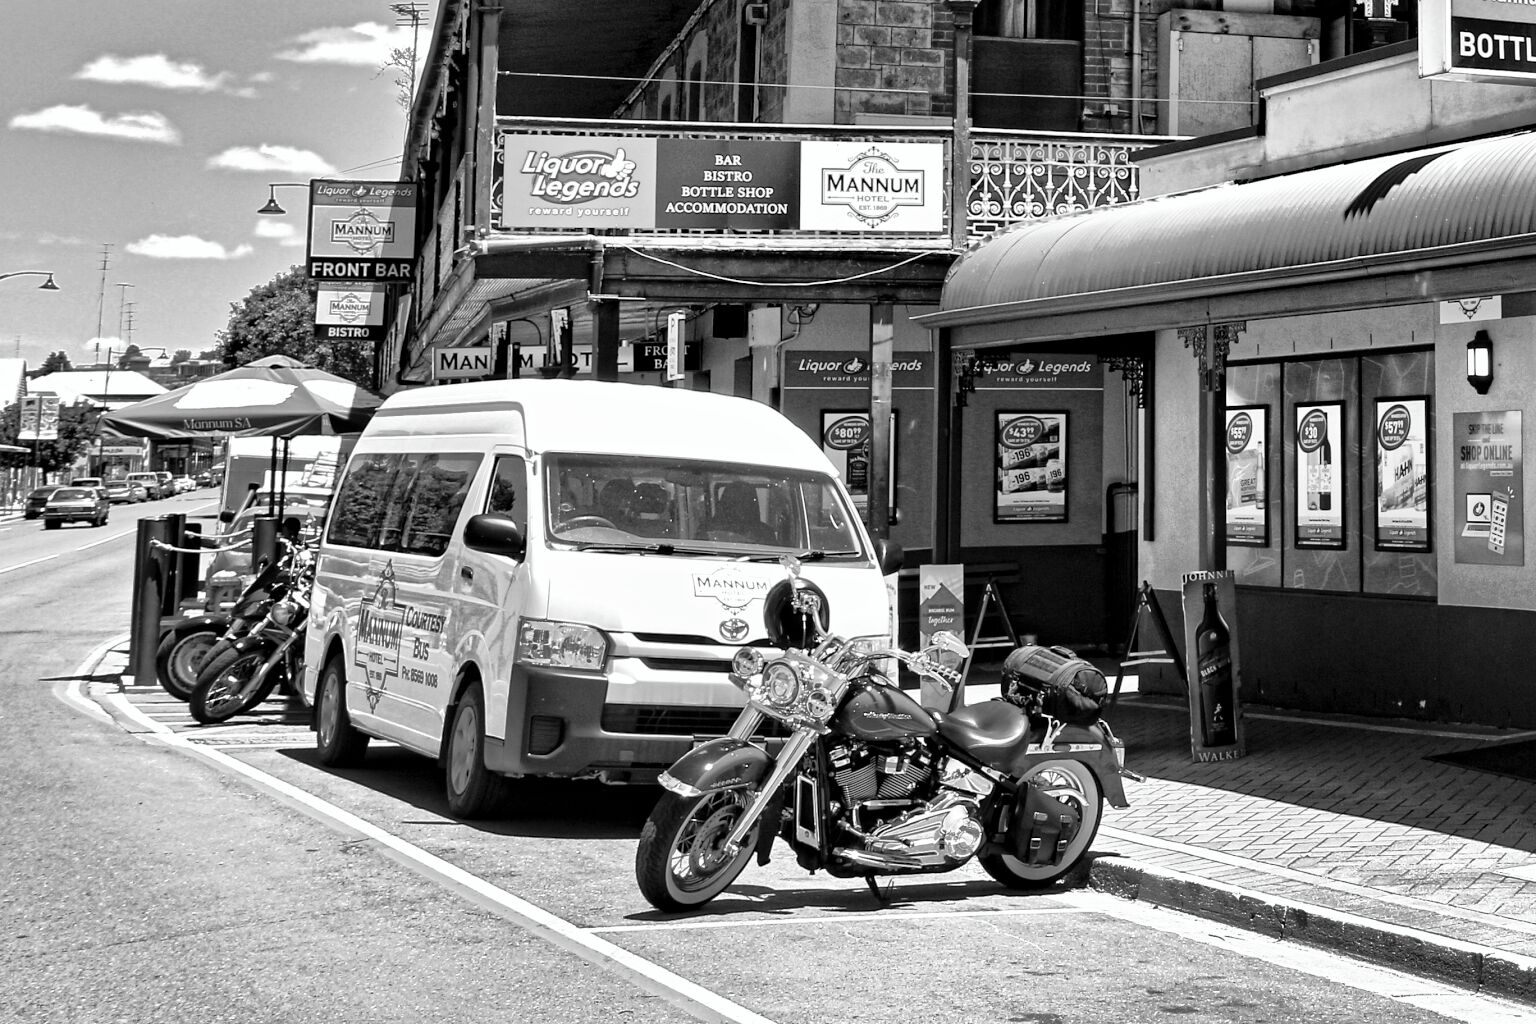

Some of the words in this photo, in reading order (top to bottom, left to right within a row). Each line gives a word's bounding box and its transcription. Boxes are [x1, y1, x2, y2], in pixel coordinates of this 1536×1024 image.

[521, 150, 605, 179] Liquor
[715, 155, 742, 166] BAR
[703, 171, 753, 183] BISTRO
[827, 174, 920, 193] MANNUM
[317, 185, 350, 195] Liquor
[369, 187, 412, 198] Legends
[532, 175, 640, 202] Legends
[681, 186, 734, 198] BOTTLE
[737, 187, 774, 198] SHOP
[857, 195, 889, 203] HOTEL
[529, 207, 573, 215] reward
[577, 207, 630, 218] yourself
[665, 202, 788, 215] ACCOMMODATION
[334, 224, 392, 236] MANNUM
[311, 262, 371, 277] FRONT
[375, 263, 411, 278] BAR
[332, 303, 369, 311] MANNUM
[328, 327, 370, 338] BISTRO
[645, 346, 690, 356] FROT
[440, 353, 533, 371] MANM
[799, 359, 842, 374] Liquor
[1038, 361, 1092, 374] Legends
[184, 418, 233, 430] Mannum
[234, 417, 252, 428] SA
[1460, 445, 1481, 461] SHOP
[1484, 444, 1513, 461] ONLINE
[1394, 459, 1413, 482] HAHN
[697, 576, 768, 590] MANNUM
[406, 606, 447, 634] COURTESY
[359, 608, 400, 650] MANNUM
[413, 637, 429, 661] BUS
[369, 651, 383, 665] HOTEL
[1200, 665, 1217, 677] BLACK
[1199, 749, 1245, 762] WALKE
